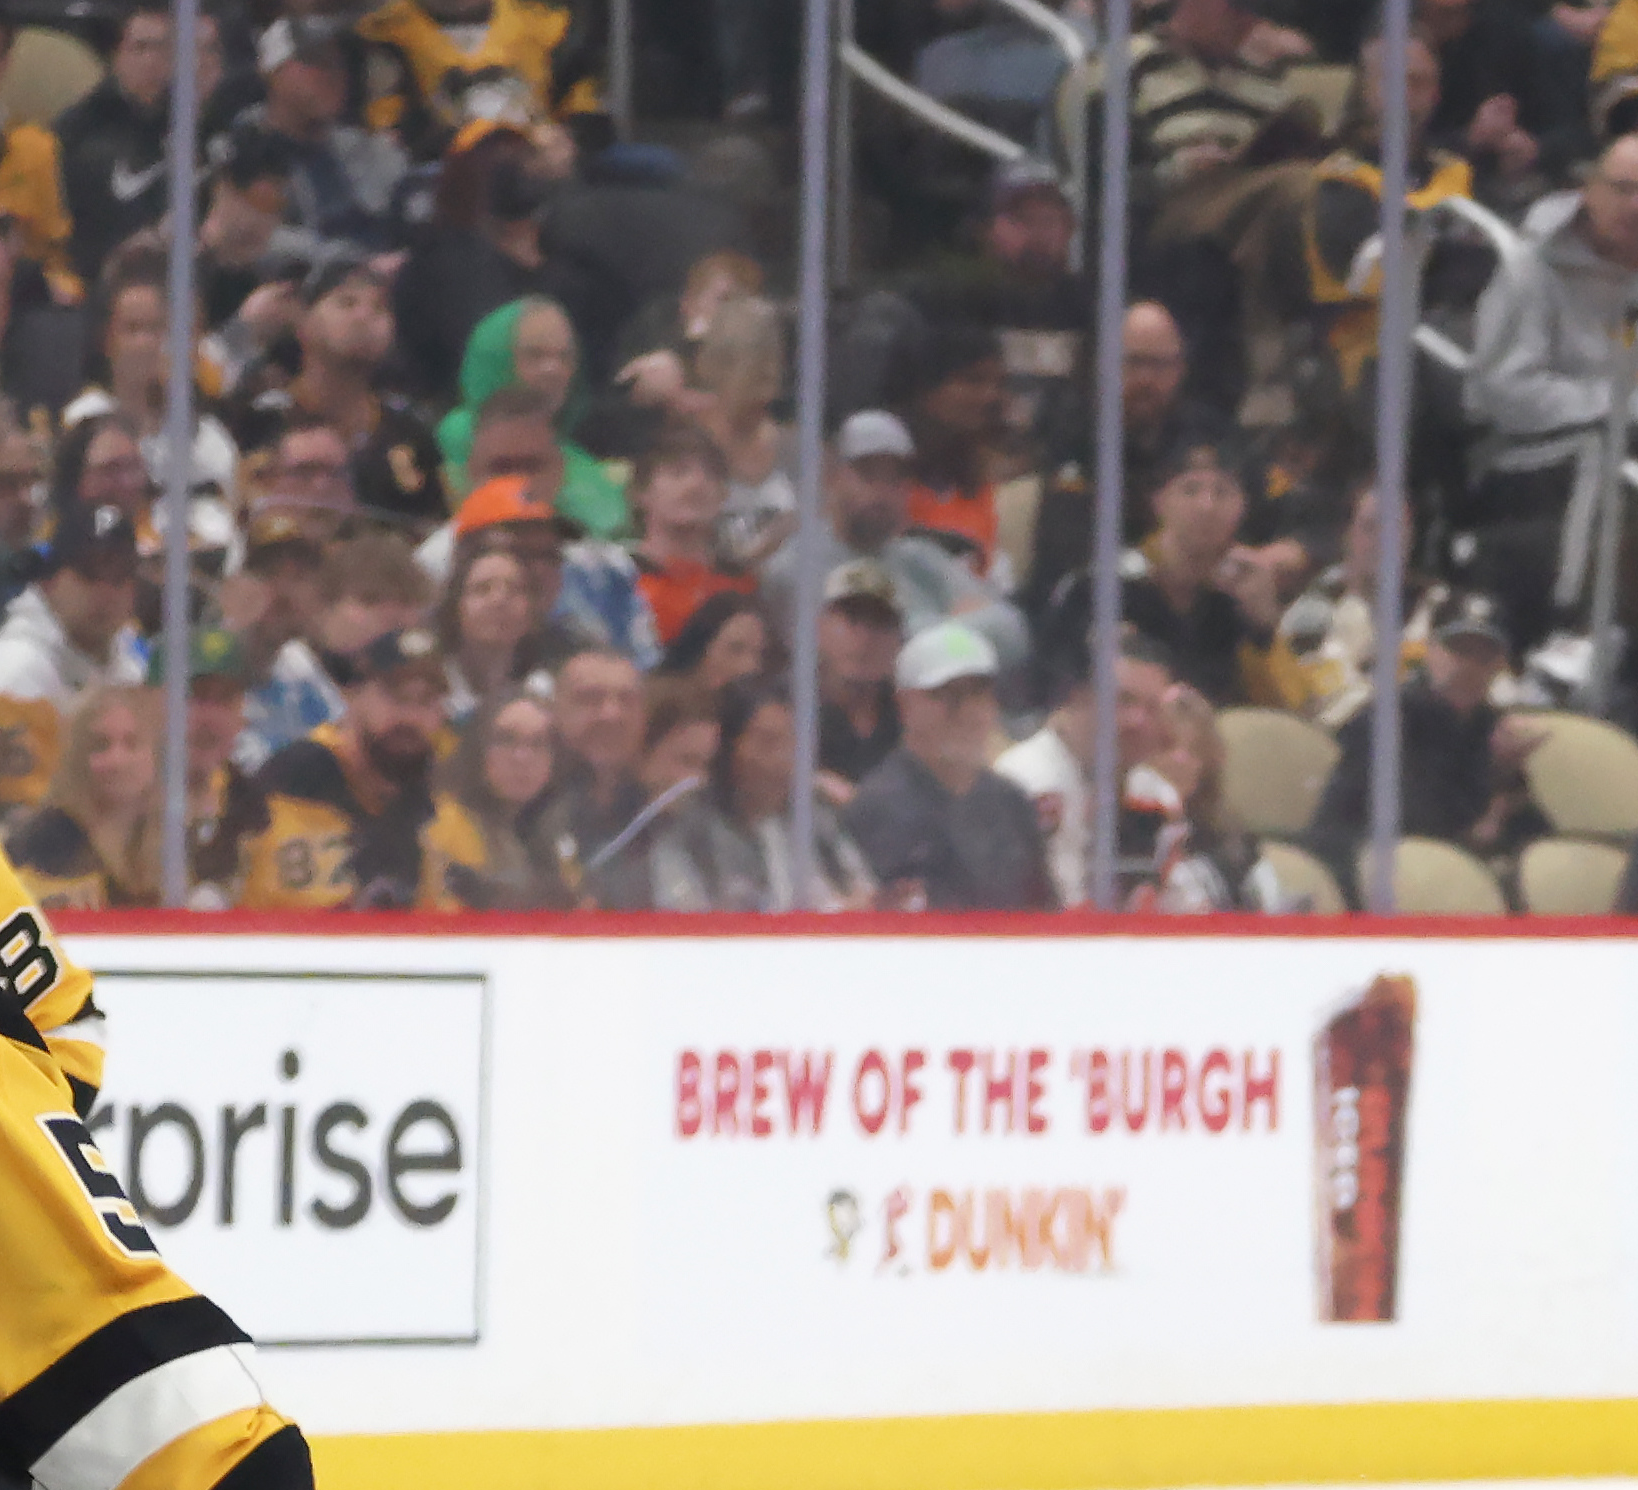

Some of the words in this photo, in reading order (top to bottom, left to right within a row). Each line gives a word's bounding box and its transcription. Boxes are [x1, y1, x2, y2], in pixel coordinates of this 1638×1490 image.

[675, 1049, 834, 1137] BREW
[851, 1049, 928, 1136] OF
[947, 1049, 1053, 1136] THE
